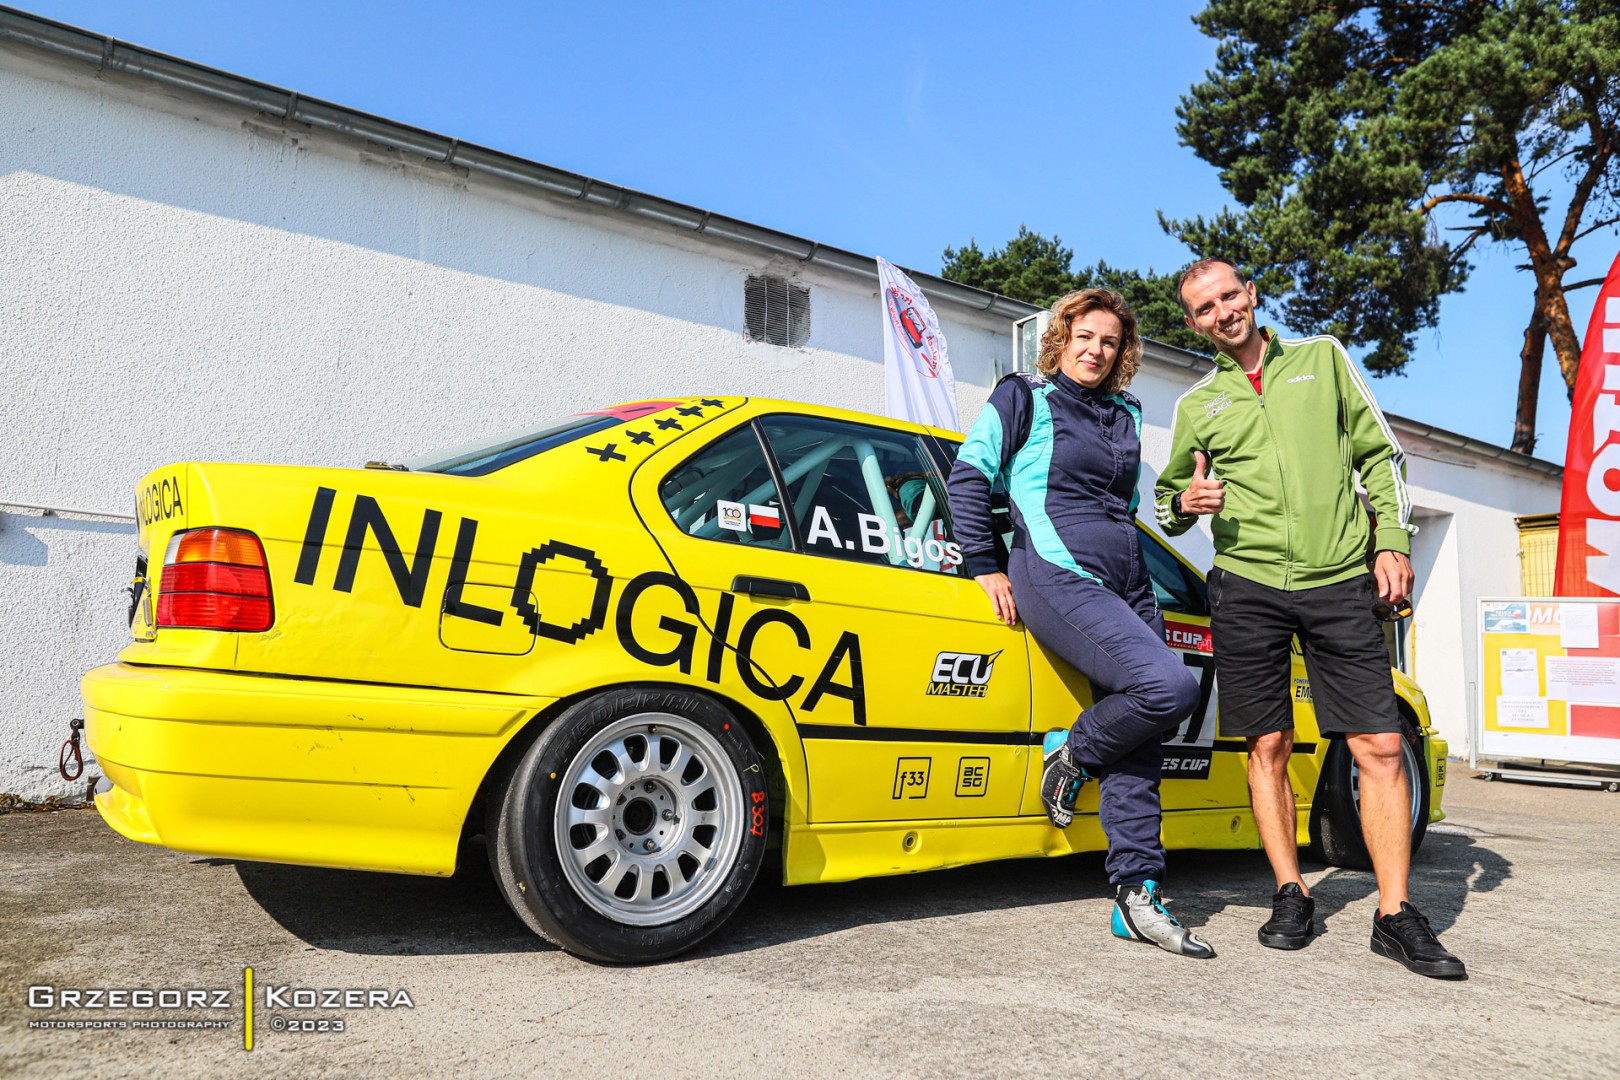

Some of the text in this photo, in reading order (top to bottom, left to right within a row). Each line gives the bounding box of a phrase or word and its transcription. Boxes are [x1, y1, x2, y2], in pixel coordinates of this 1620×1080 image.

[1287, 374, 1316, 384] adidas
[294, 486, 867, 727] INLOGICA
[1172, 630, 1203, 645] CUP
[931, 651, 995, 685] ECU
[926, 683, 988, 697] MASTER
[1180, 758, 1209, 771] CUP
